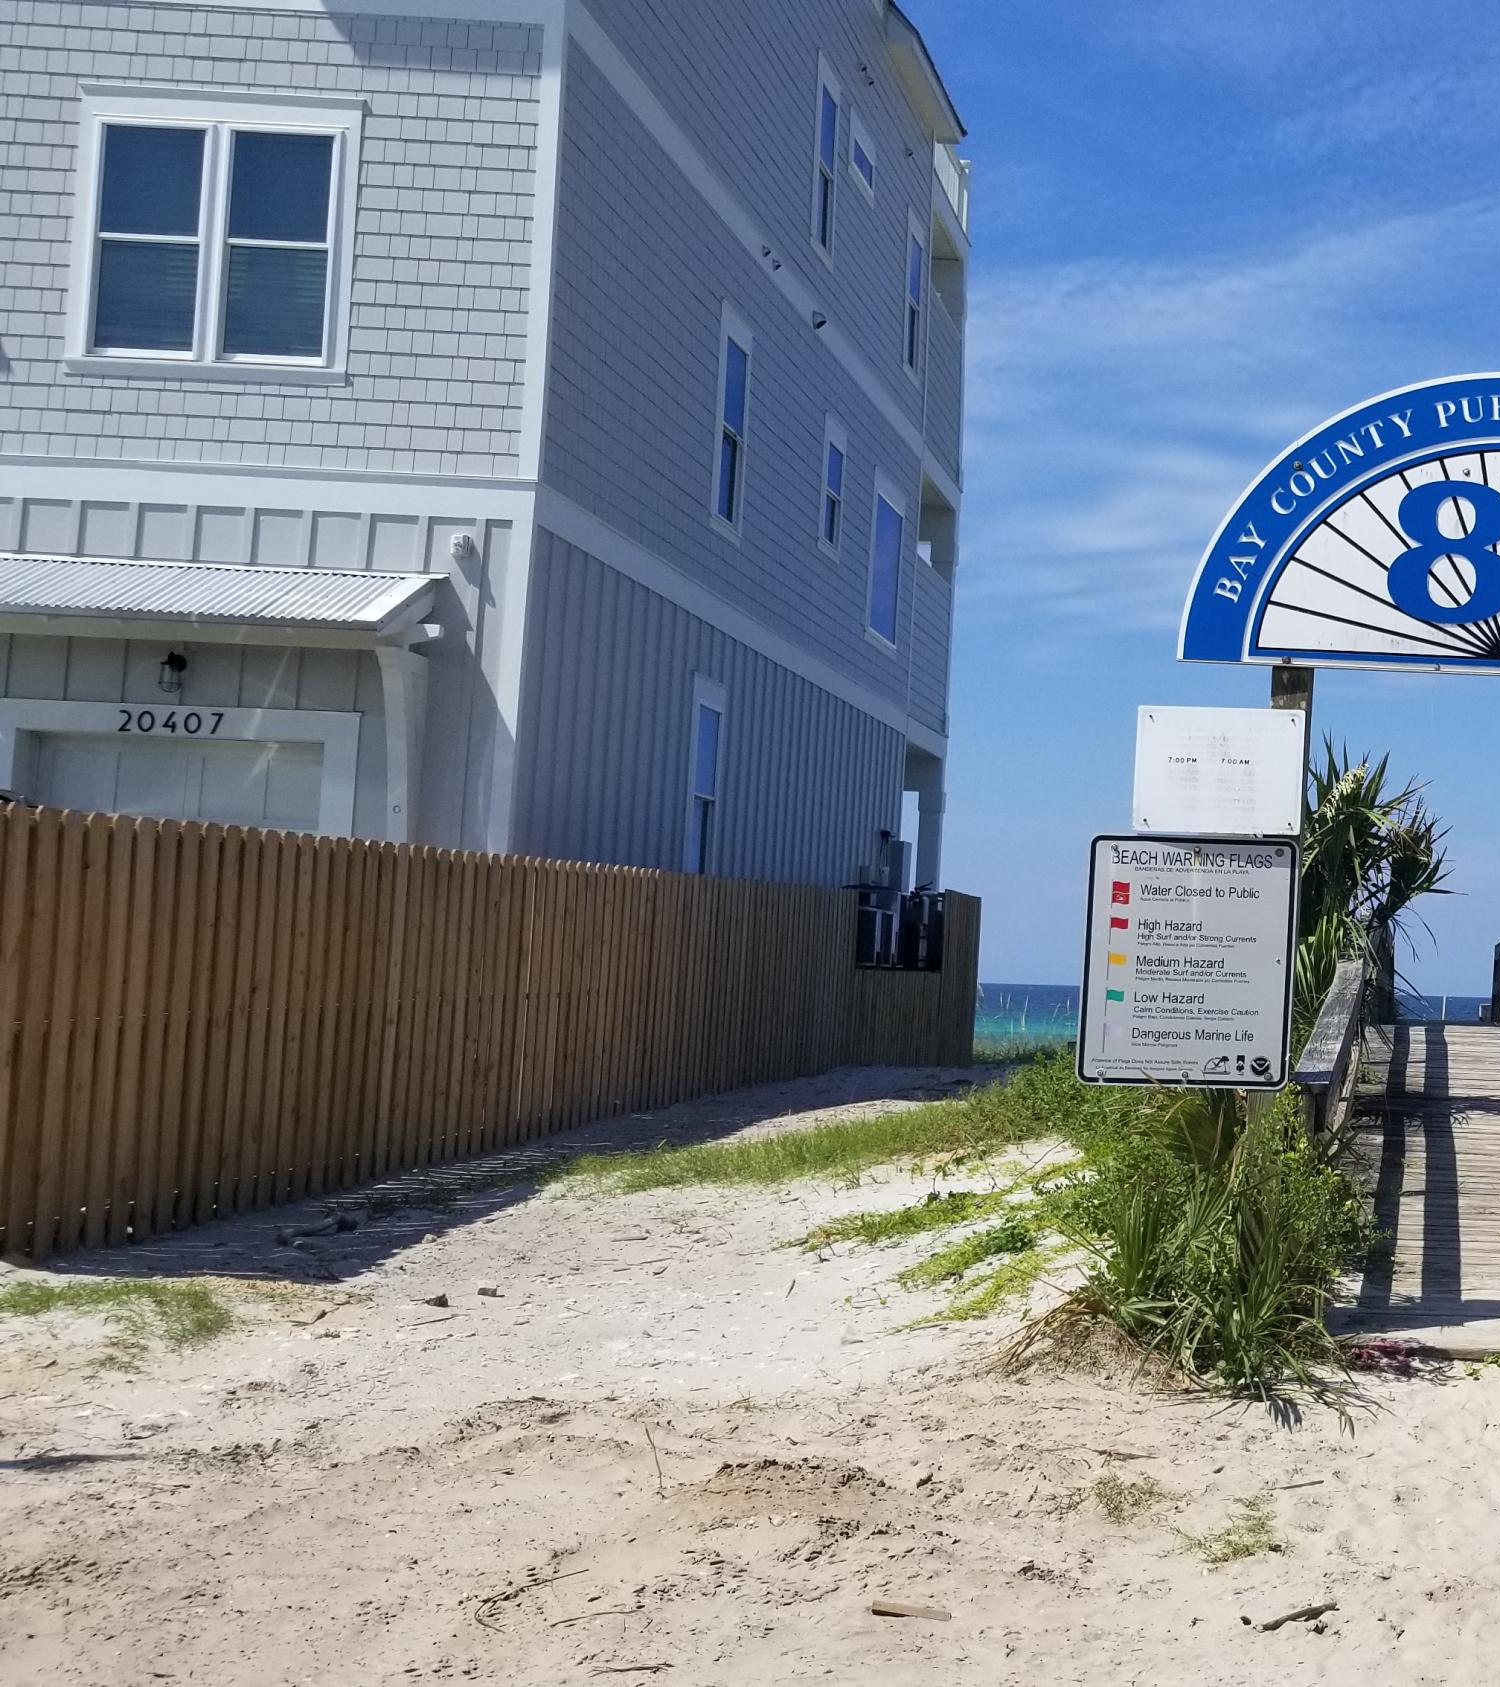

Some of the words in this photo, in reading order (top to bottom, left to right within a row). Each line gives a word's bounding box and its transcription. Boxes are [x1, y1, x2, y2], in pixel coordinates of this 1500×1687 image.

[1213, 521, 1267, 603] BAY
[1270, 409, 1414, 514] COUNTY
[118, 709, 224, 734] 20407
[1112, 850, 1158, 866] BEACH
[1162, 851, 1225, 868] WARNING
[1229, 853, 1272, 869] FLAGS
[1140, 884, 1171, 896] Water
[1175, 885, 1212, 897] Closed
[1215, 888, 1225, 898] to
[1229, 886, 1260, 899] Public
[1138, 918, 1161, 933] High
[1165, 919, 1203, 932] Hazard
[1137, 933, 1154, 942] High
[1156, 933, 1172, 941] Surf
[1199, 934, 1223, 943] Strong
[1226, 935, 1257, 943] Currents
[1136, 955, 1180, 967] Medium
[1184, 956, 1224, 969] Hazard
[1136, 968, 1170, 976] Moderate
[1134, 991, 1158, 1003] Low
[1162, 992, 1205, 1004] Hazard
[1231, 1008, 1259, 1016] Caution
[1131, 1027, 1191, 1042] Dangerous
[1195, 1028, 1231, 1041] Marine
[1234, 1030, 1254, 1042] Life
